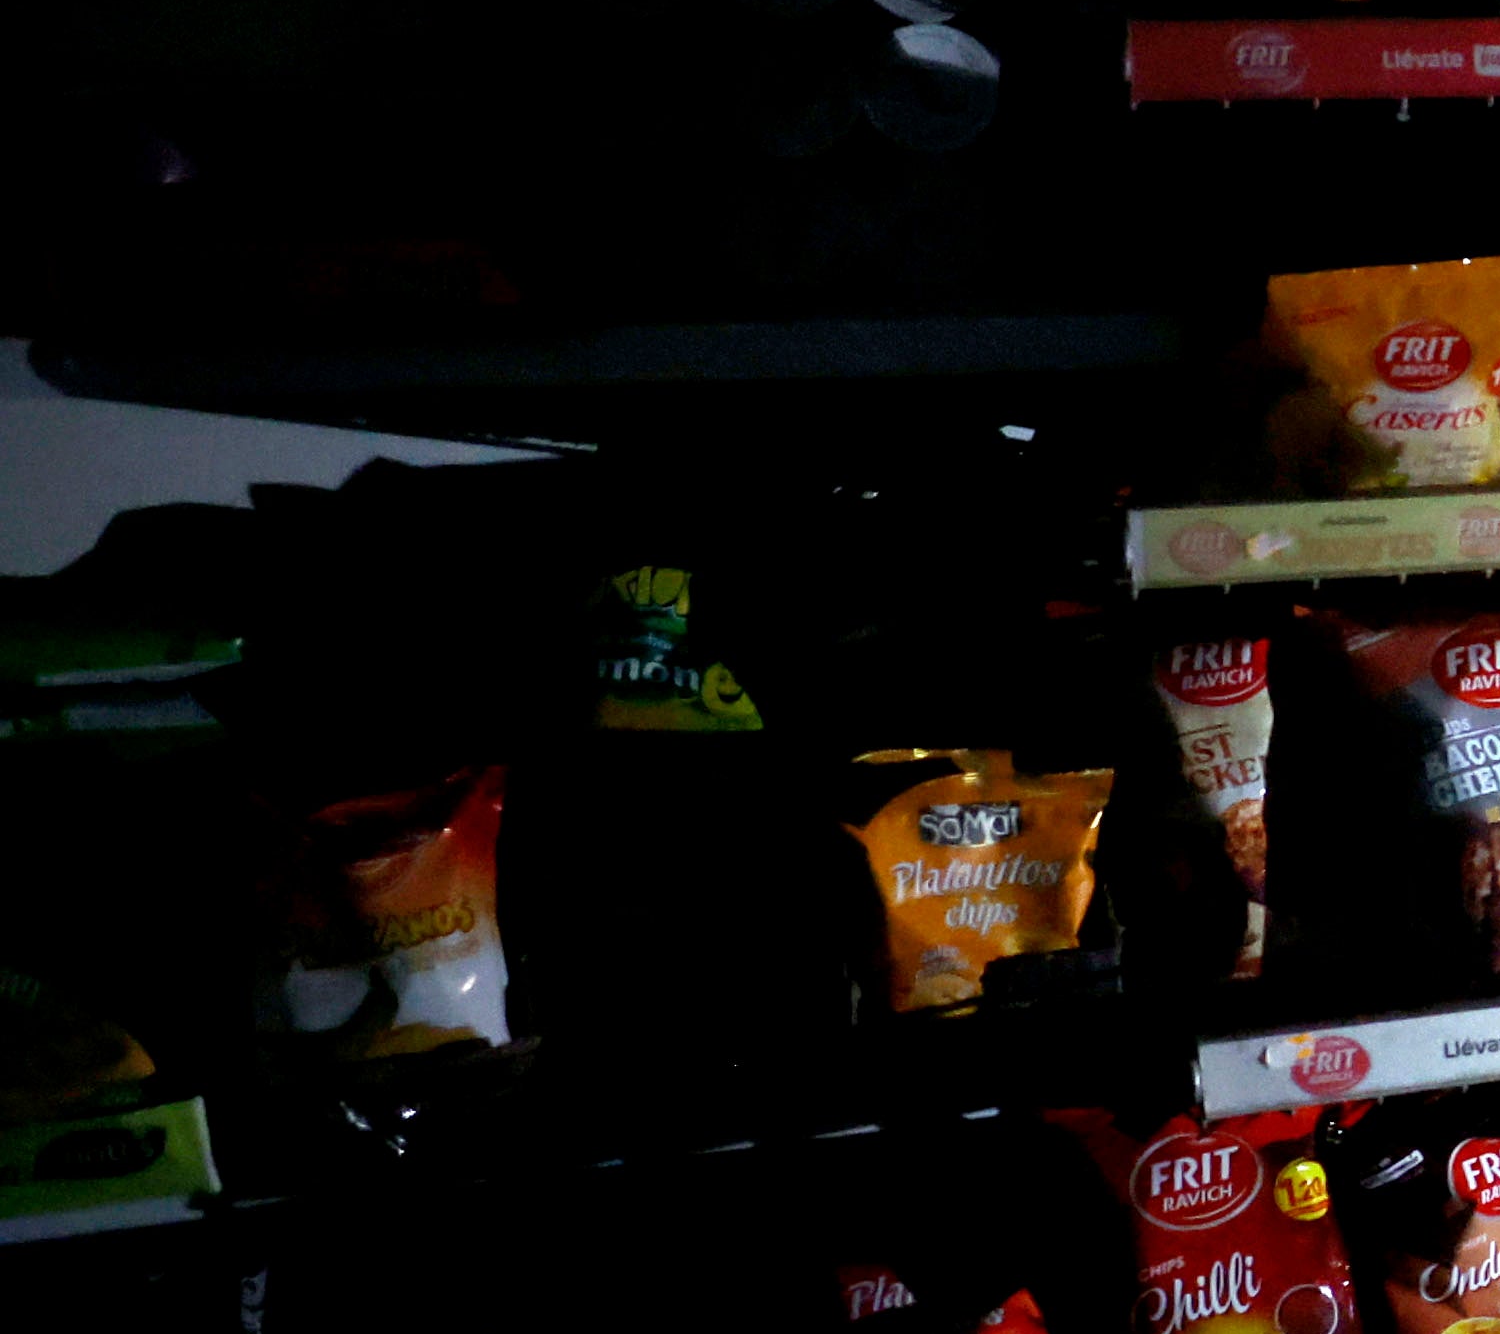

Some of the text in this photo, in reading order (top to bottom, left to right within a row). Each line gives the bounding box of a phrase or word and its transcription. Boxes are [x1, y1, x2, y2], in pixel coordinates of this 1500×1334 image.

[1235, 44, 1294, 67] FRIT
[1382, 50, 1465, 69] Llévate
[1384, 335, 1461, 362] FRIT
[1181, 667, 1253, 691] RAVICH
[890, 853, 1064, 906] Platanitos
[944, 896, 1019, 937] chips
[1300, 1047, 1358, 1073] FRIT
[1151, 1145, 1240, 1198] FRIT
[1163, 1182, 1233, 1212] RAVICH
